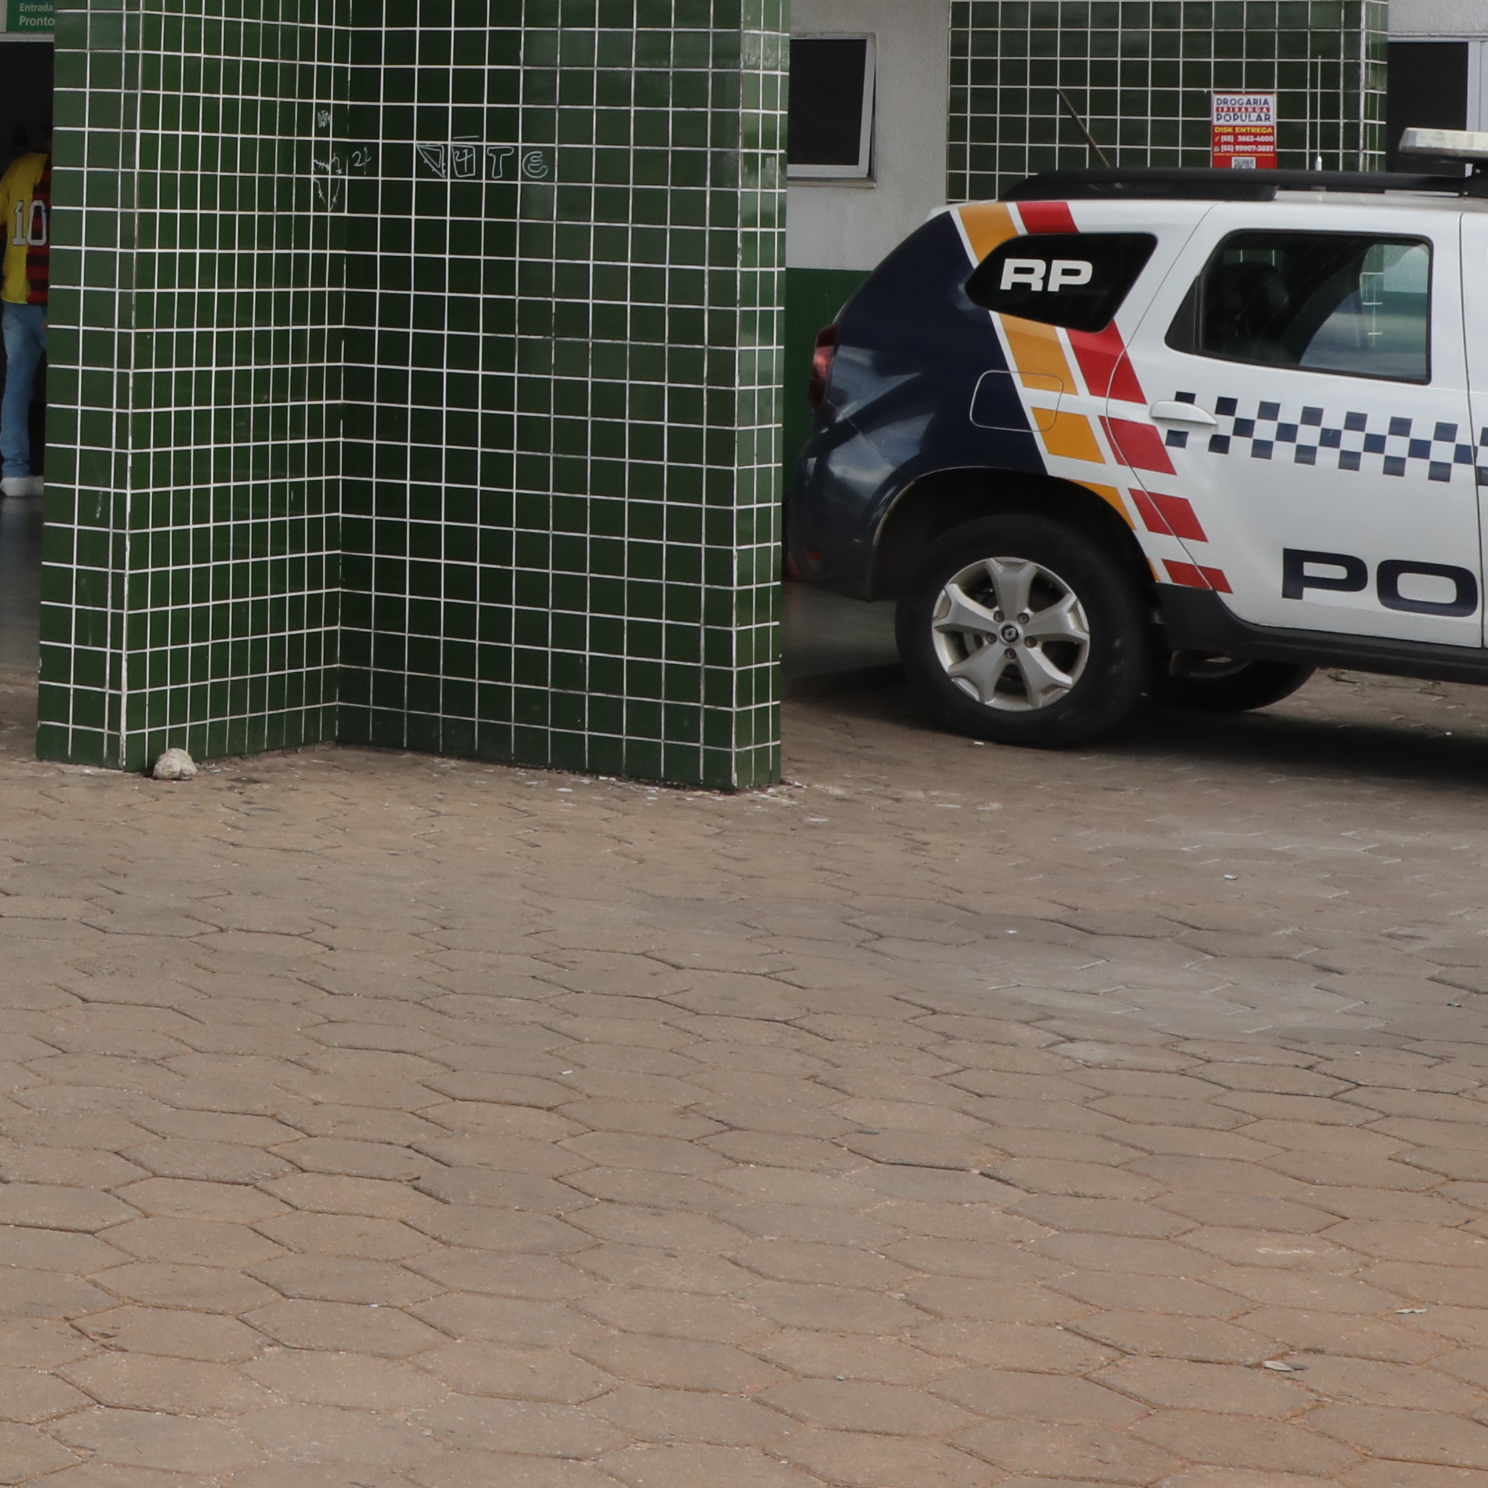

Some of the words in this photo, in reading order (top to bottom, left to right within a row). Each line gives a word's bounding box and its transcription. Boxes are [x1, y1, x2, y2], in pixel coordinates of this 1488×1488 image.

[19, 3, 54, 12] Entrada
[19, 15, 55, 27] Pronto
[1216, 98, 1270, 106] DROGARIA
[1216, 113, 1271, 122] POPULAR
[12, 200, 47, 246] 10
[999, 258, 1093, 292] RP
